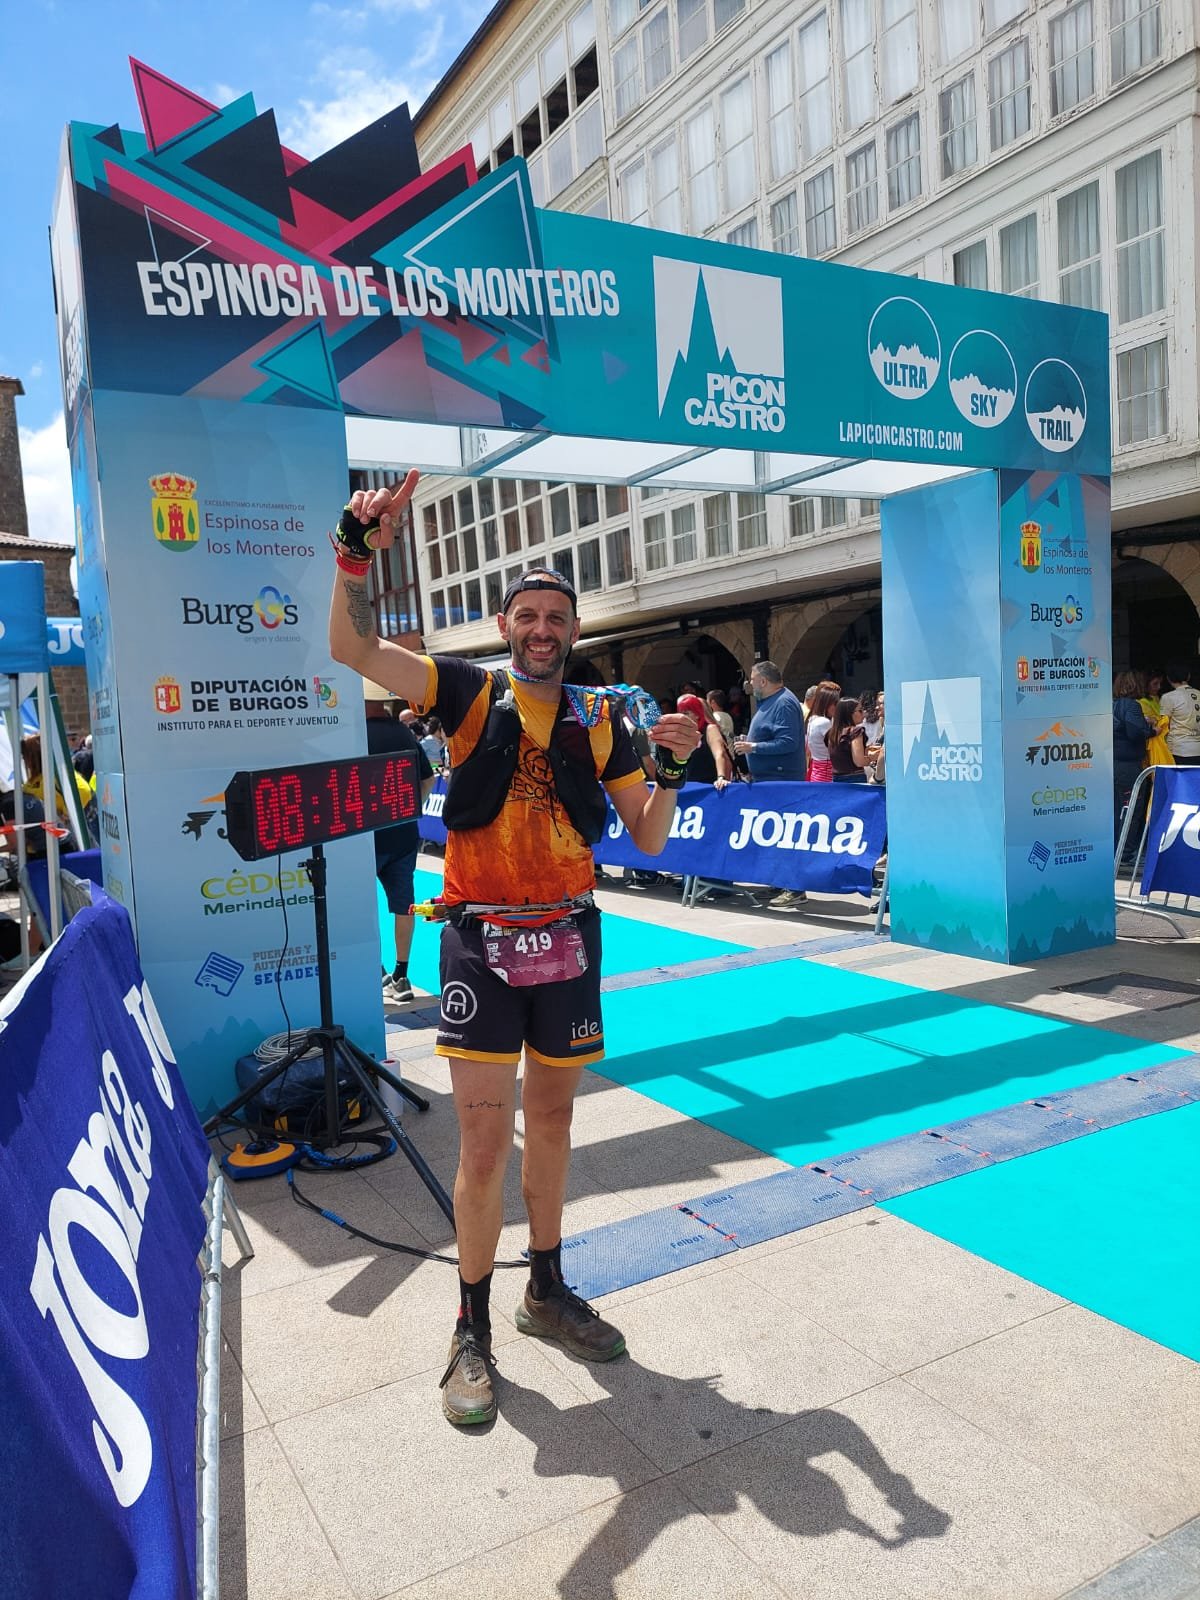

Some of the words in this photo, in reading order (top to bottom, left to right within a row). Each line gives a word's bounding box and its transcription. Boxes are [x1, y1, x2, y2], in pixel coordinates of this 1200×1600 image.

[137, 261, 327, 317] ESPINOSA
[331, 266, 379, 317] DE
[384, 266, 446, 317] LOS
[454, 268, 620, 317] MONTEROS
[883, 361, 928, 390] ULTRA
[970, 393, 998, 418] SKY
[685, 398, 785, 433] CASTRO
[839, 421, 963, 451] LAPICONCASTRO.COM
[1039, 418, 1074, 442] TRAIL
[205, 513, 279, 532] Espinosa
[284, 516, 304, 532] de
[207, 538, 231, 554] los
[236, 540, 315, 557] Monteros
[1043, 547, 1076, 560] Espinosa
[1079, 549, 1089, 559] de
[1043, 564, 1054, 575] los
[1056, 564, 1093, 575] Monteros
[181, 586, 298, 634] Burgos
[1030, 595, 1083, 627] Burgos
[1033, 656, 1085, 668] DIPUTACIÓN
[1033, 670, 1045, 680] DE
[1049, 669, 1086, 680] BURGOS
[191, 676, 307, 695] DIPUTACIÓN
[192, 698, 220, 713] DE
[229, 696, 309, 712] BURGOS
[157, 721, 206, 732] INSTITUTO
[208, 720, 232, 729] PARA
[234, 719, 245, 729] EL
[247, 717, 287, 728] DEPORTE
[288, 717, 294, 726] Y
[295, 716, 339, 726] JUVENTUD
[918, 763, 983, 782] CASTRO
[255, 759, 415, 851] 08:14:46
[1033, 803, 1087, 817] Merindades
[1054, 854, 1087, 865] SECADES
[204, 894, 316, 916] Merindades
[515, 932, 552, 954] 419
[253, 947, 301, 961] PUERTAS
[303, 945, 312, 954] Y
[254, 951, 337, 972] AUTOMATISS
[670, 1234, 705, 1249] Feibot
